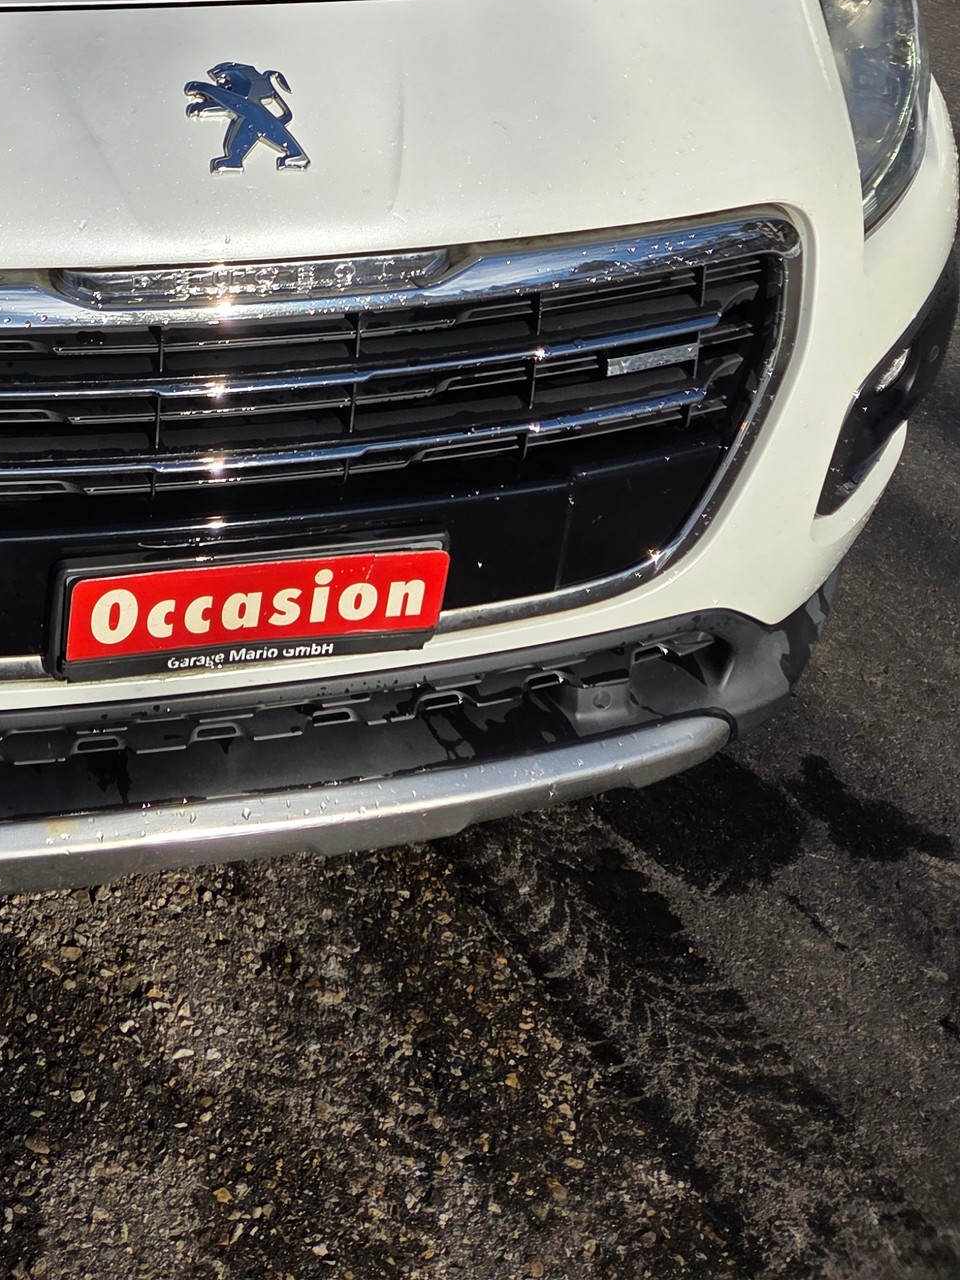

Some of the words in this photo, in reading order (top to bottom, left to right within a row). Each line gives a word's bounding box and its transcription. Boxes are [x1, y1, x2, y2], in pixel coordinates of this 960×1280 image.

[90, 569, 426, 645] Occasion
[167, 652, 225, 669] Garage
[229, 646, 279, 662] Mario
[282, 642, 334, 658] GmbH
